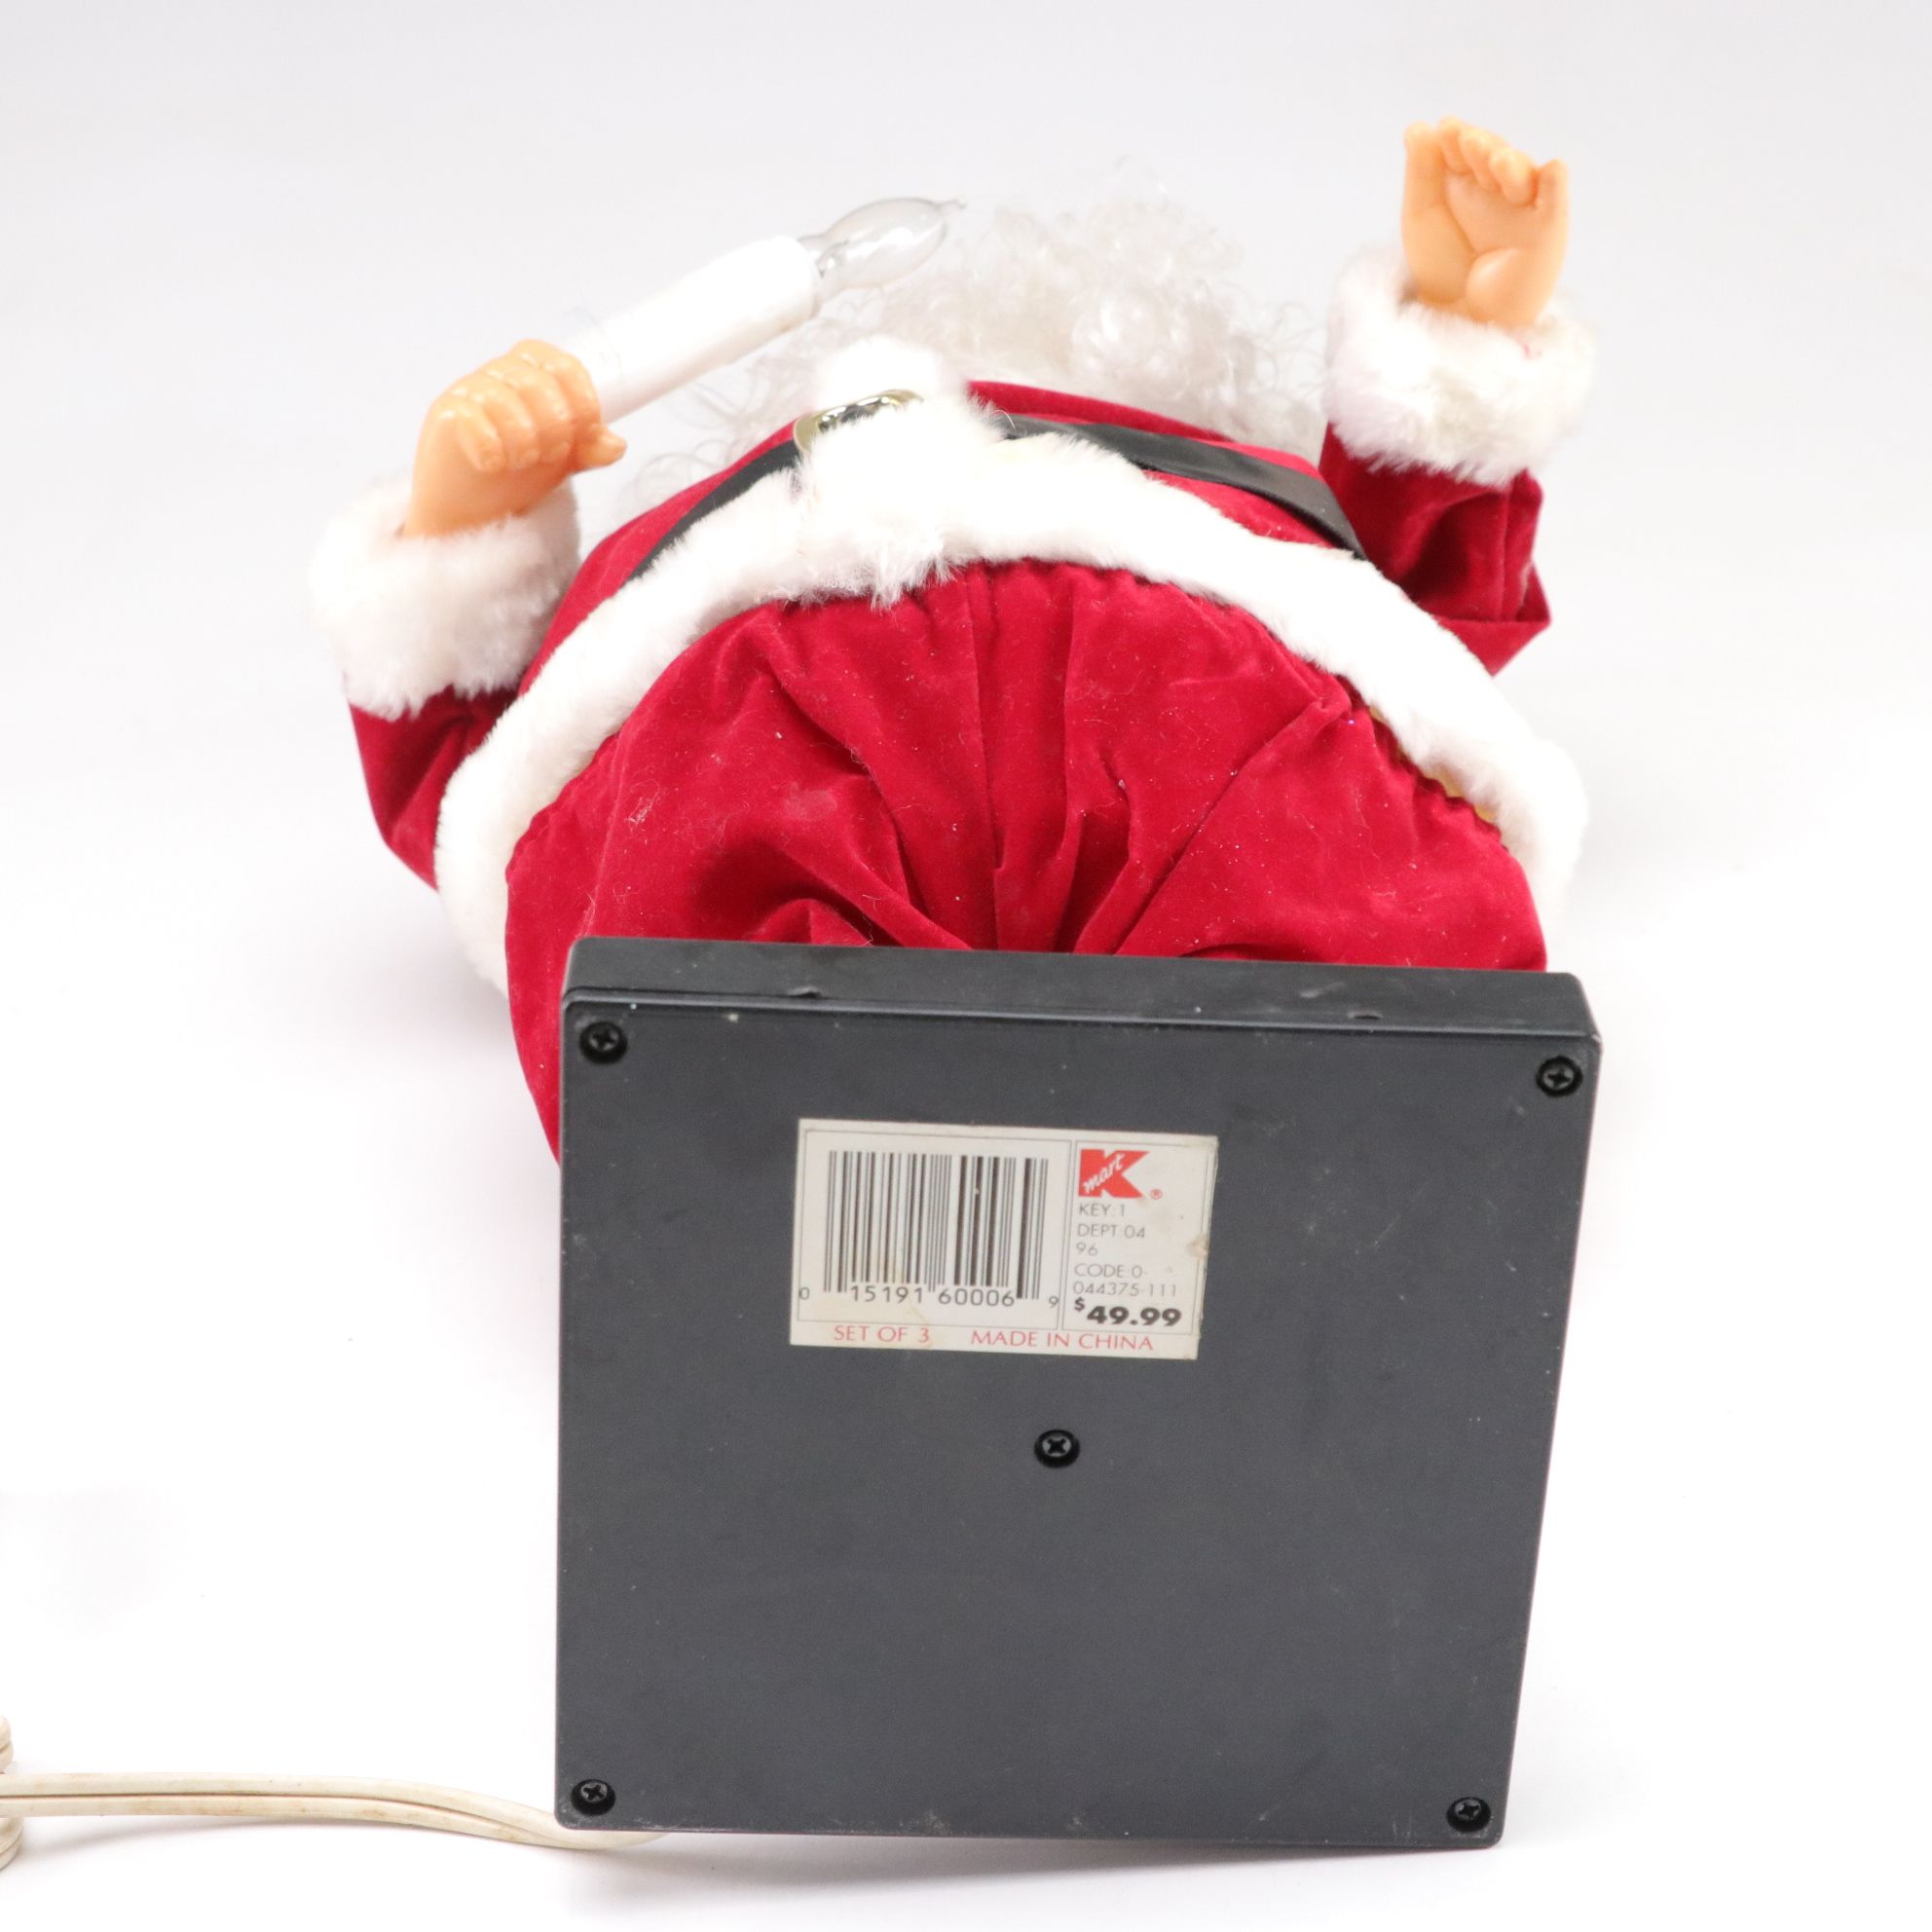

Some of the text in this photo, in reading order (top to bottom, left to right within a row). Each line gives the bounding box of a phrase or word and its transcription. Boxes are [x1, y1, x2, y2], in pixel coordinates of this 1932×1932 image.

[1075, 1242, 1098, 1256] 96
[850, 1285, 924, 1304] 15191
[938, 1287, 1016, 1307] 60006
[1048, 1295, 1059, 1309] 9
[1073, 1281, 1176, 1297] 044375-111
[1074, 1296, 1182, 1326] $49.99
[834, 1324, 930, 1344] SET OF 3
[970, 1330, 1154, 1351] MADE IN CHINA
